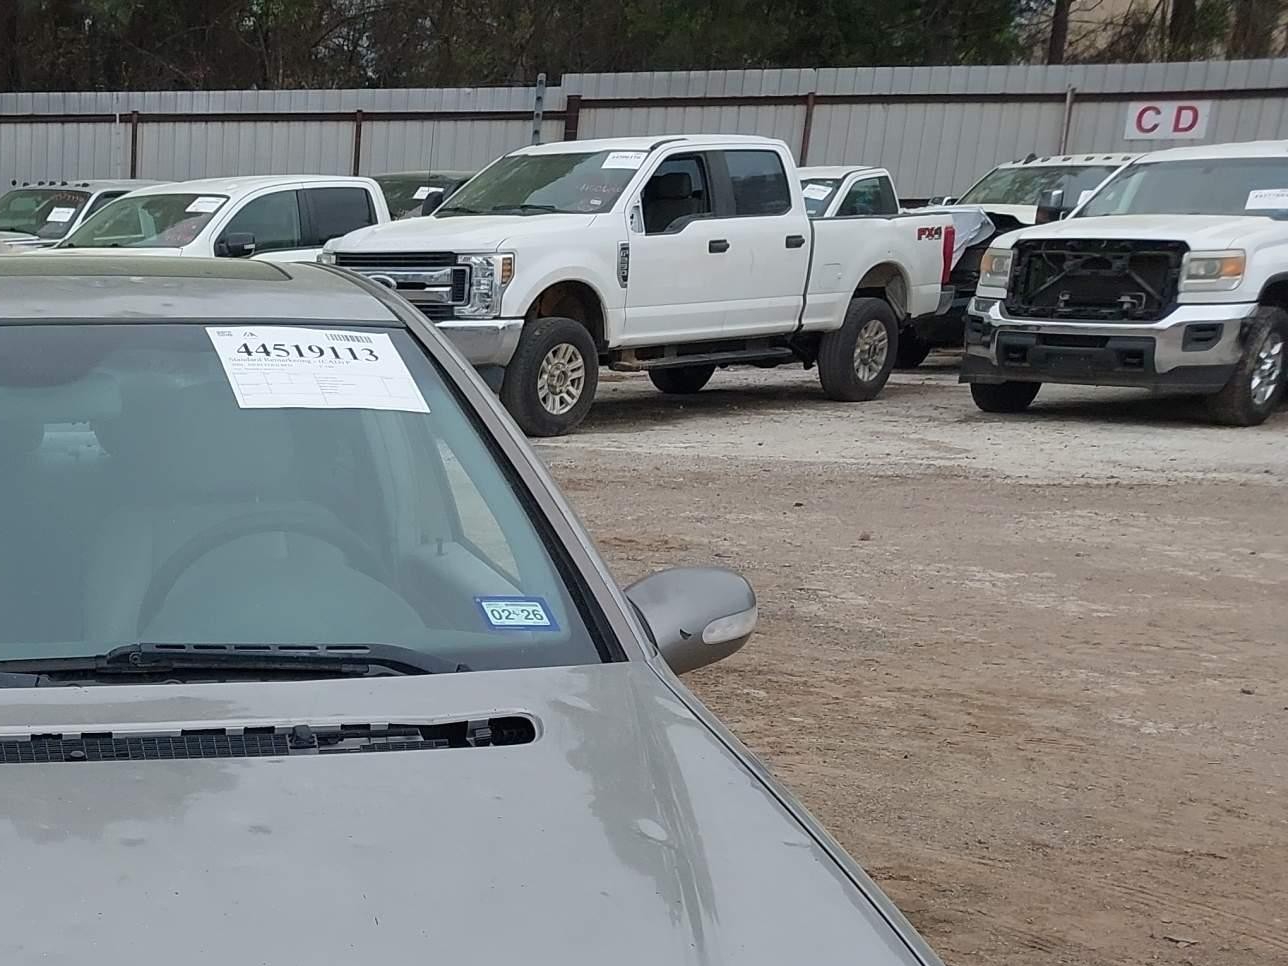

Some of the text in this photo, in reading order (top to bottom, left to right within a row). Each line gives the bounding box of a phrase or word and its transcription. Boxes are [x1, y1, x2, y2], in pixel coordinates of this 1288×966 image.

[1135, 105, 1199, 133] C D
[917, 226, 942, 240] FX4
[236, 342, 379, 362] 44519113
[490, 608, 544, 621] 02 26
